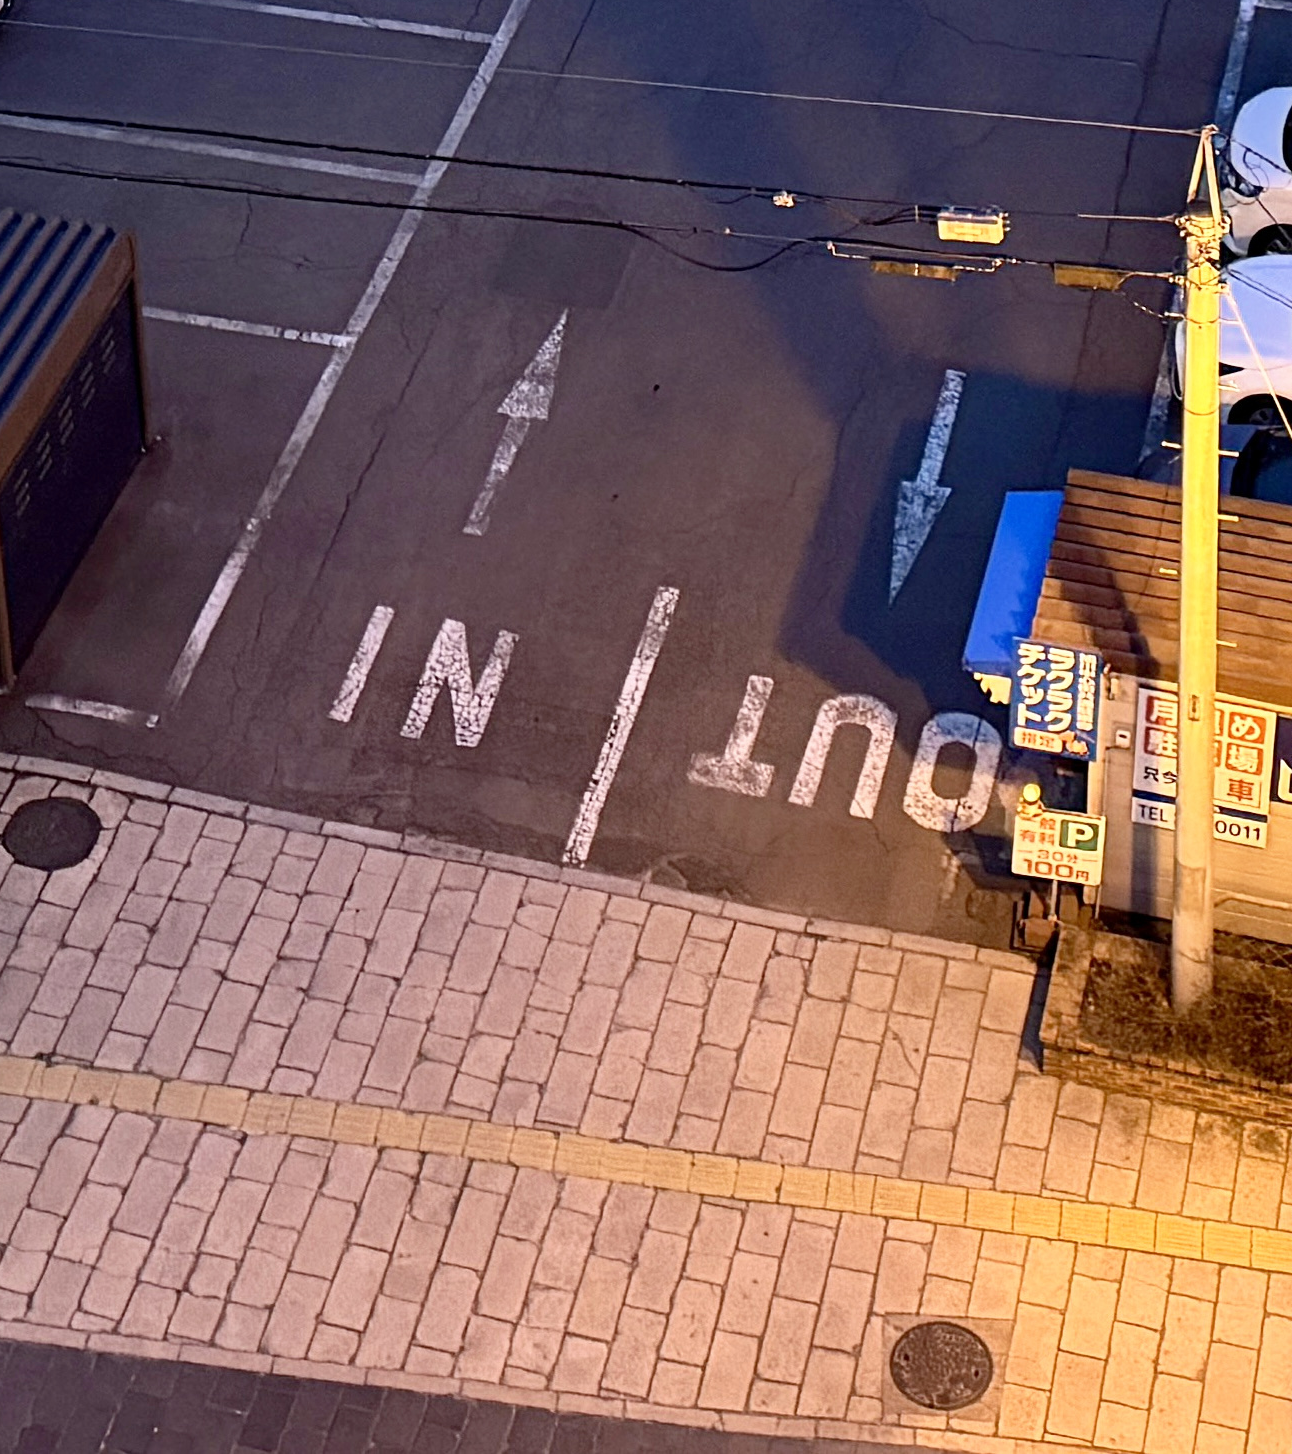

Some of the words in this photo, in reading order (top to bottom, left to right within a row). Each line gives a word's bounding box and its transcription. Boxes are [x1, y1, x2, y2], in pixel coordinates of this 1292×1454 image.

[327, 605, 518, 747] IN
[1017, 643, 1046, 726] チケット
[1044, 647, 1075, 733] ラクラク
[1149, 698, 1261, 741] 月め
[688, 674, 1006, 833] OUT
[1147, 730, 1259, 773] 駐場
[1067, 821, 1095, 847] P
[1137, 804, 1168, 823] TEL
[1022, 858, 1089, 881] 100円
